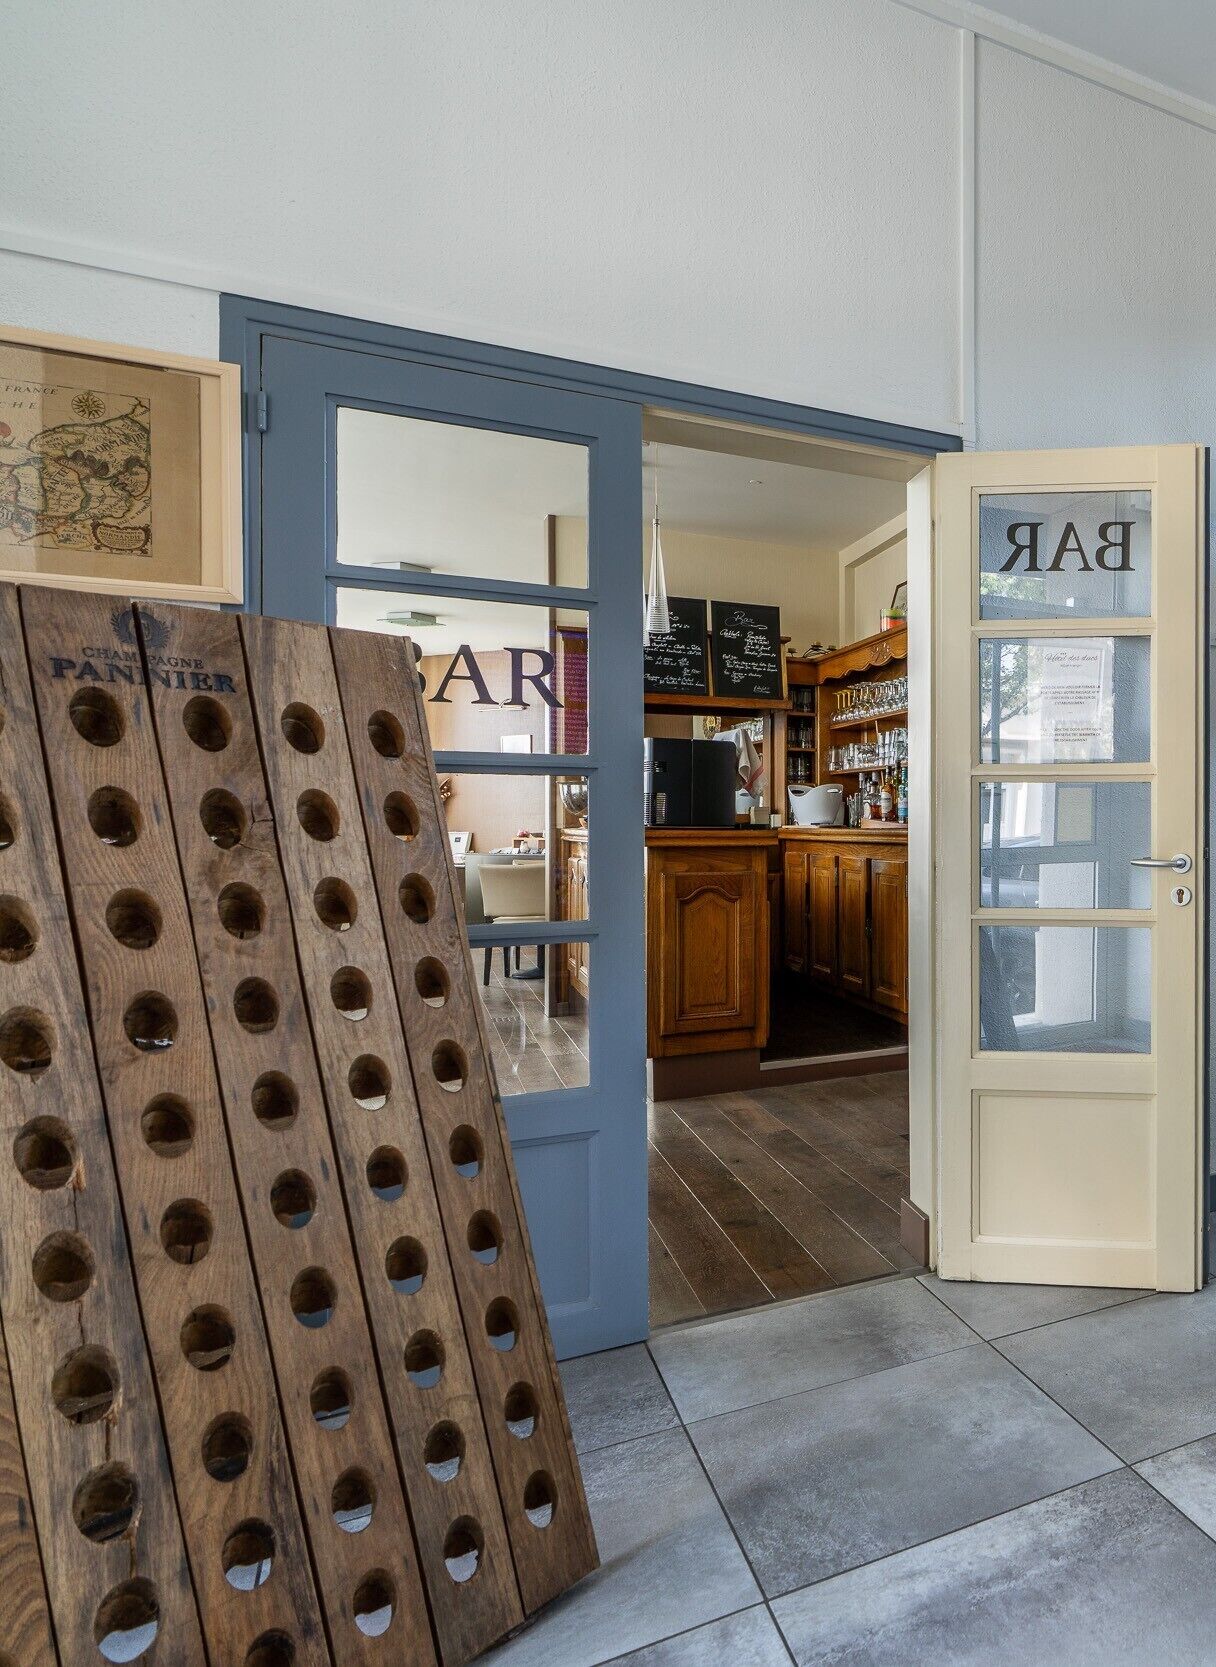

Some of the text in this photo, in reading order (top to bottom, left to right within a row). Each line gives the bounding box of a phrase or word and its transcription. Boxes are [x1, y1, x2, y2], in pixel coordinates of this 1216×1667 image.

[5, 385, 59, 395] FRANCE
[82, 647, 204, 669] CHAMPAGNE
[49, 657, 237, 693] PANNIER
